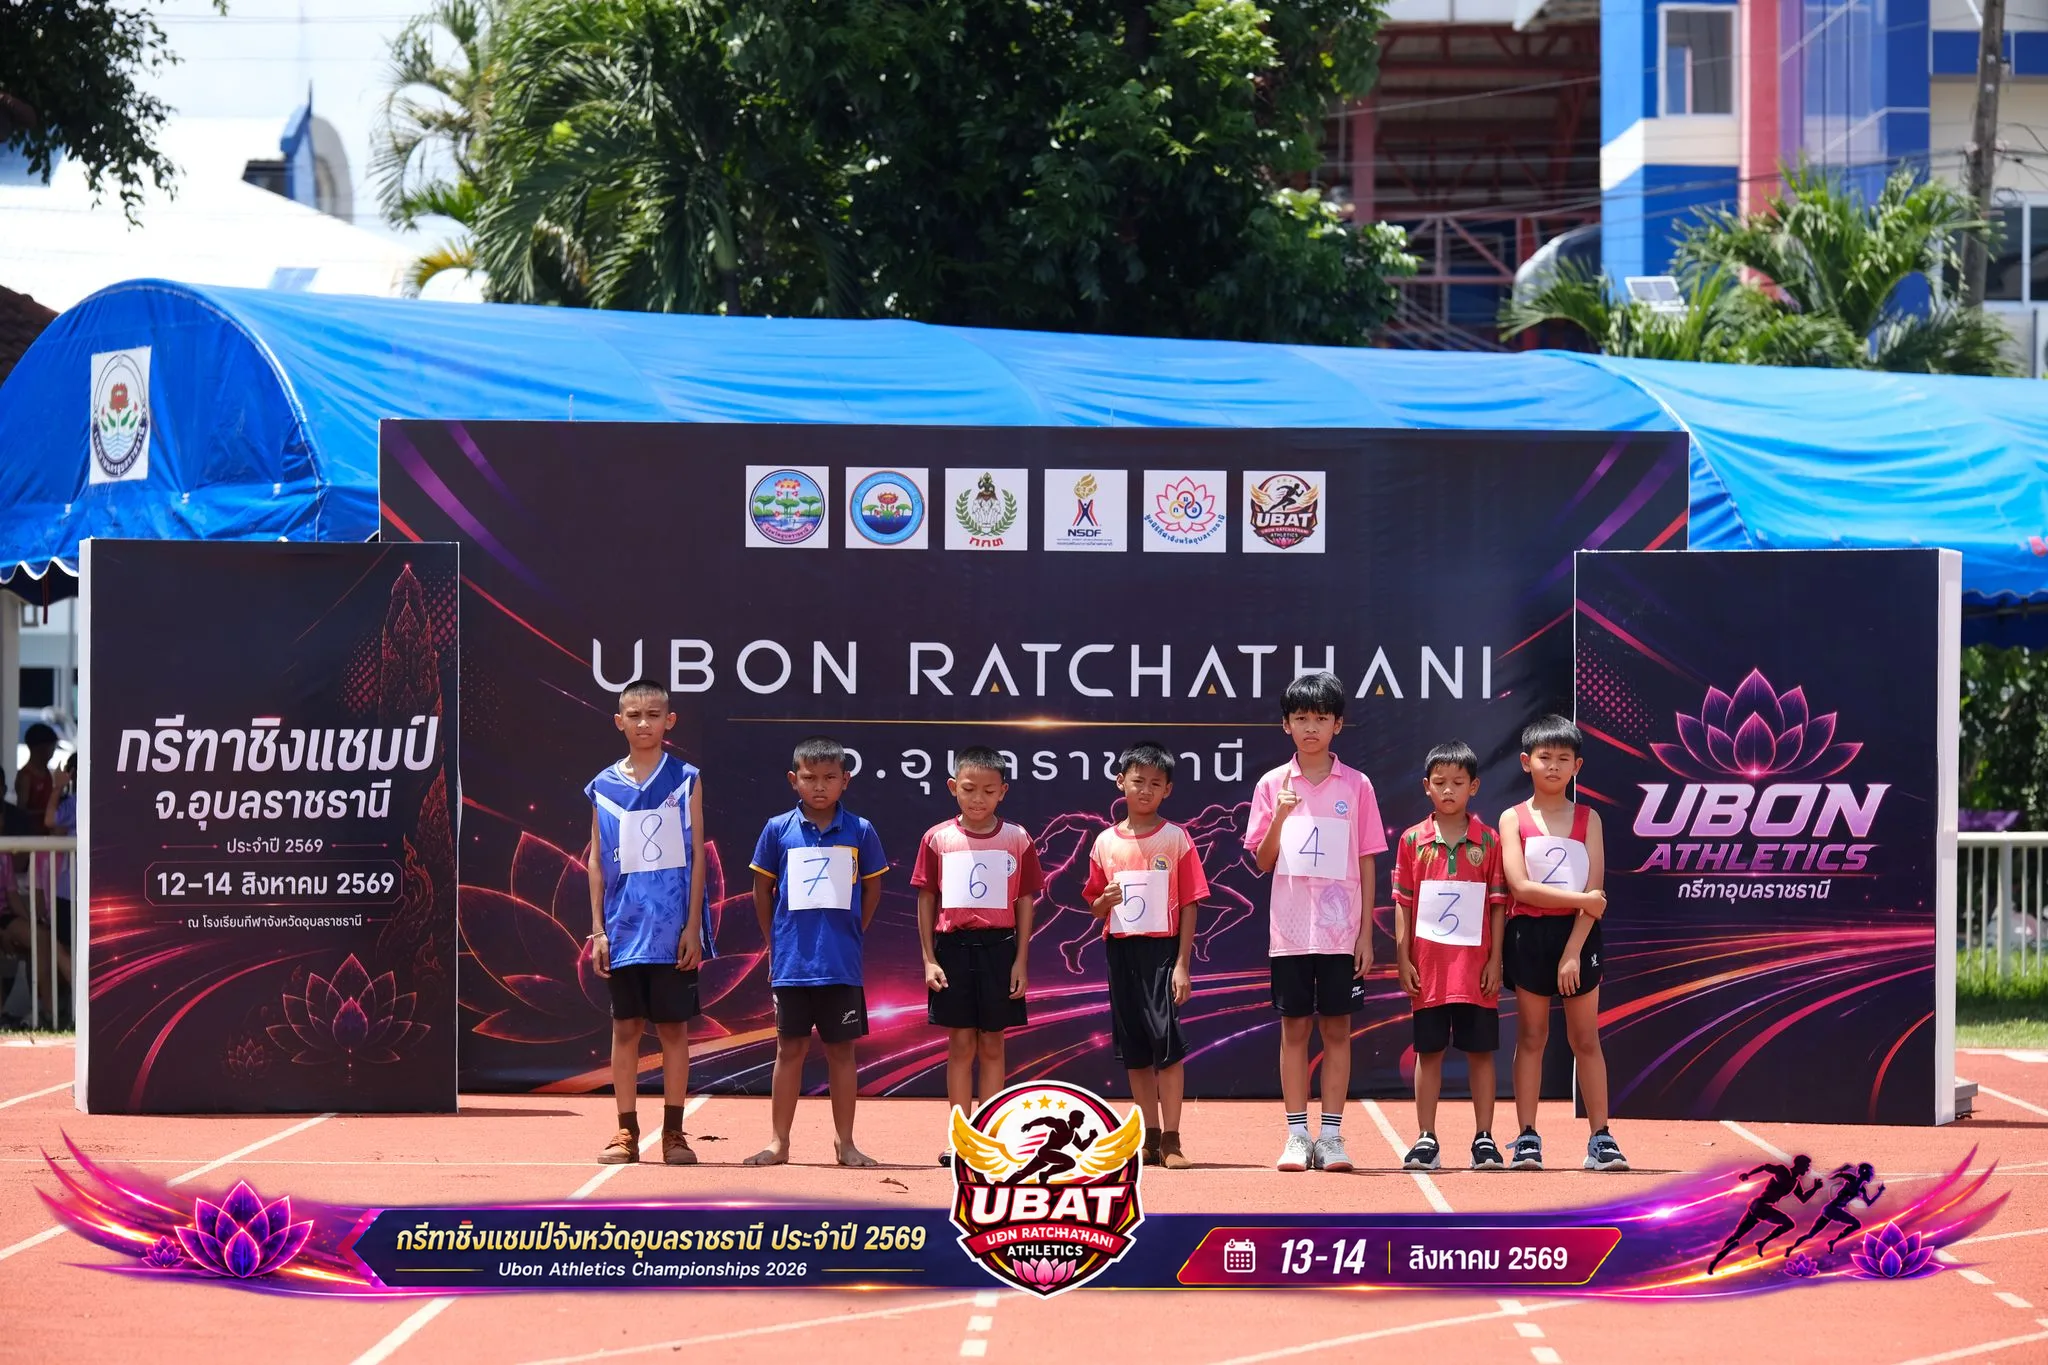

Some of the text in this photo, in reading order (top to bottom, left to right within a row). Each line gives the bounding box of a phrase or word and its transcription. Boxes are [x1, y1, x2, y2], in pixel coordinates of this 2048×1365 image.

[1067, 528, 1102, 538] NSDF
[1255, 512, 1313, 527] UBAT
[969, 536, 1004, 547] กกท
[593, 638, 857, 695] UBON
[117, 714, 438, 773] กรีฑาชิงแชมป์
[155, 778, 392, 831] จ.อุบลราชธานี
[1633, 783, 1891, 838] UBON
[227, 836, 324, 854] ประจำปี 2569
[640, 813, 663, 863] 8
[1298, 826, 1325, 867] 4
[1634, 843, 1880, 872] ATHLETICS
[157, 871, 395, 896] 12-14 สิงหาคม 2569
[803, 857, 831, 896] 7
[969, 862, 988, 899] 6
[1541, 846, 1569, 885] 2
[1123, 883, 1148, 923] 5
[1677, 878, 1831, 905] กรีฑาอุบลราชธานี
[187, 914, 362, 931] ณ โรงเรียนกีฬาจังหวัดอุบลราชธานี
[1431, 892, 1461, 937] 3
